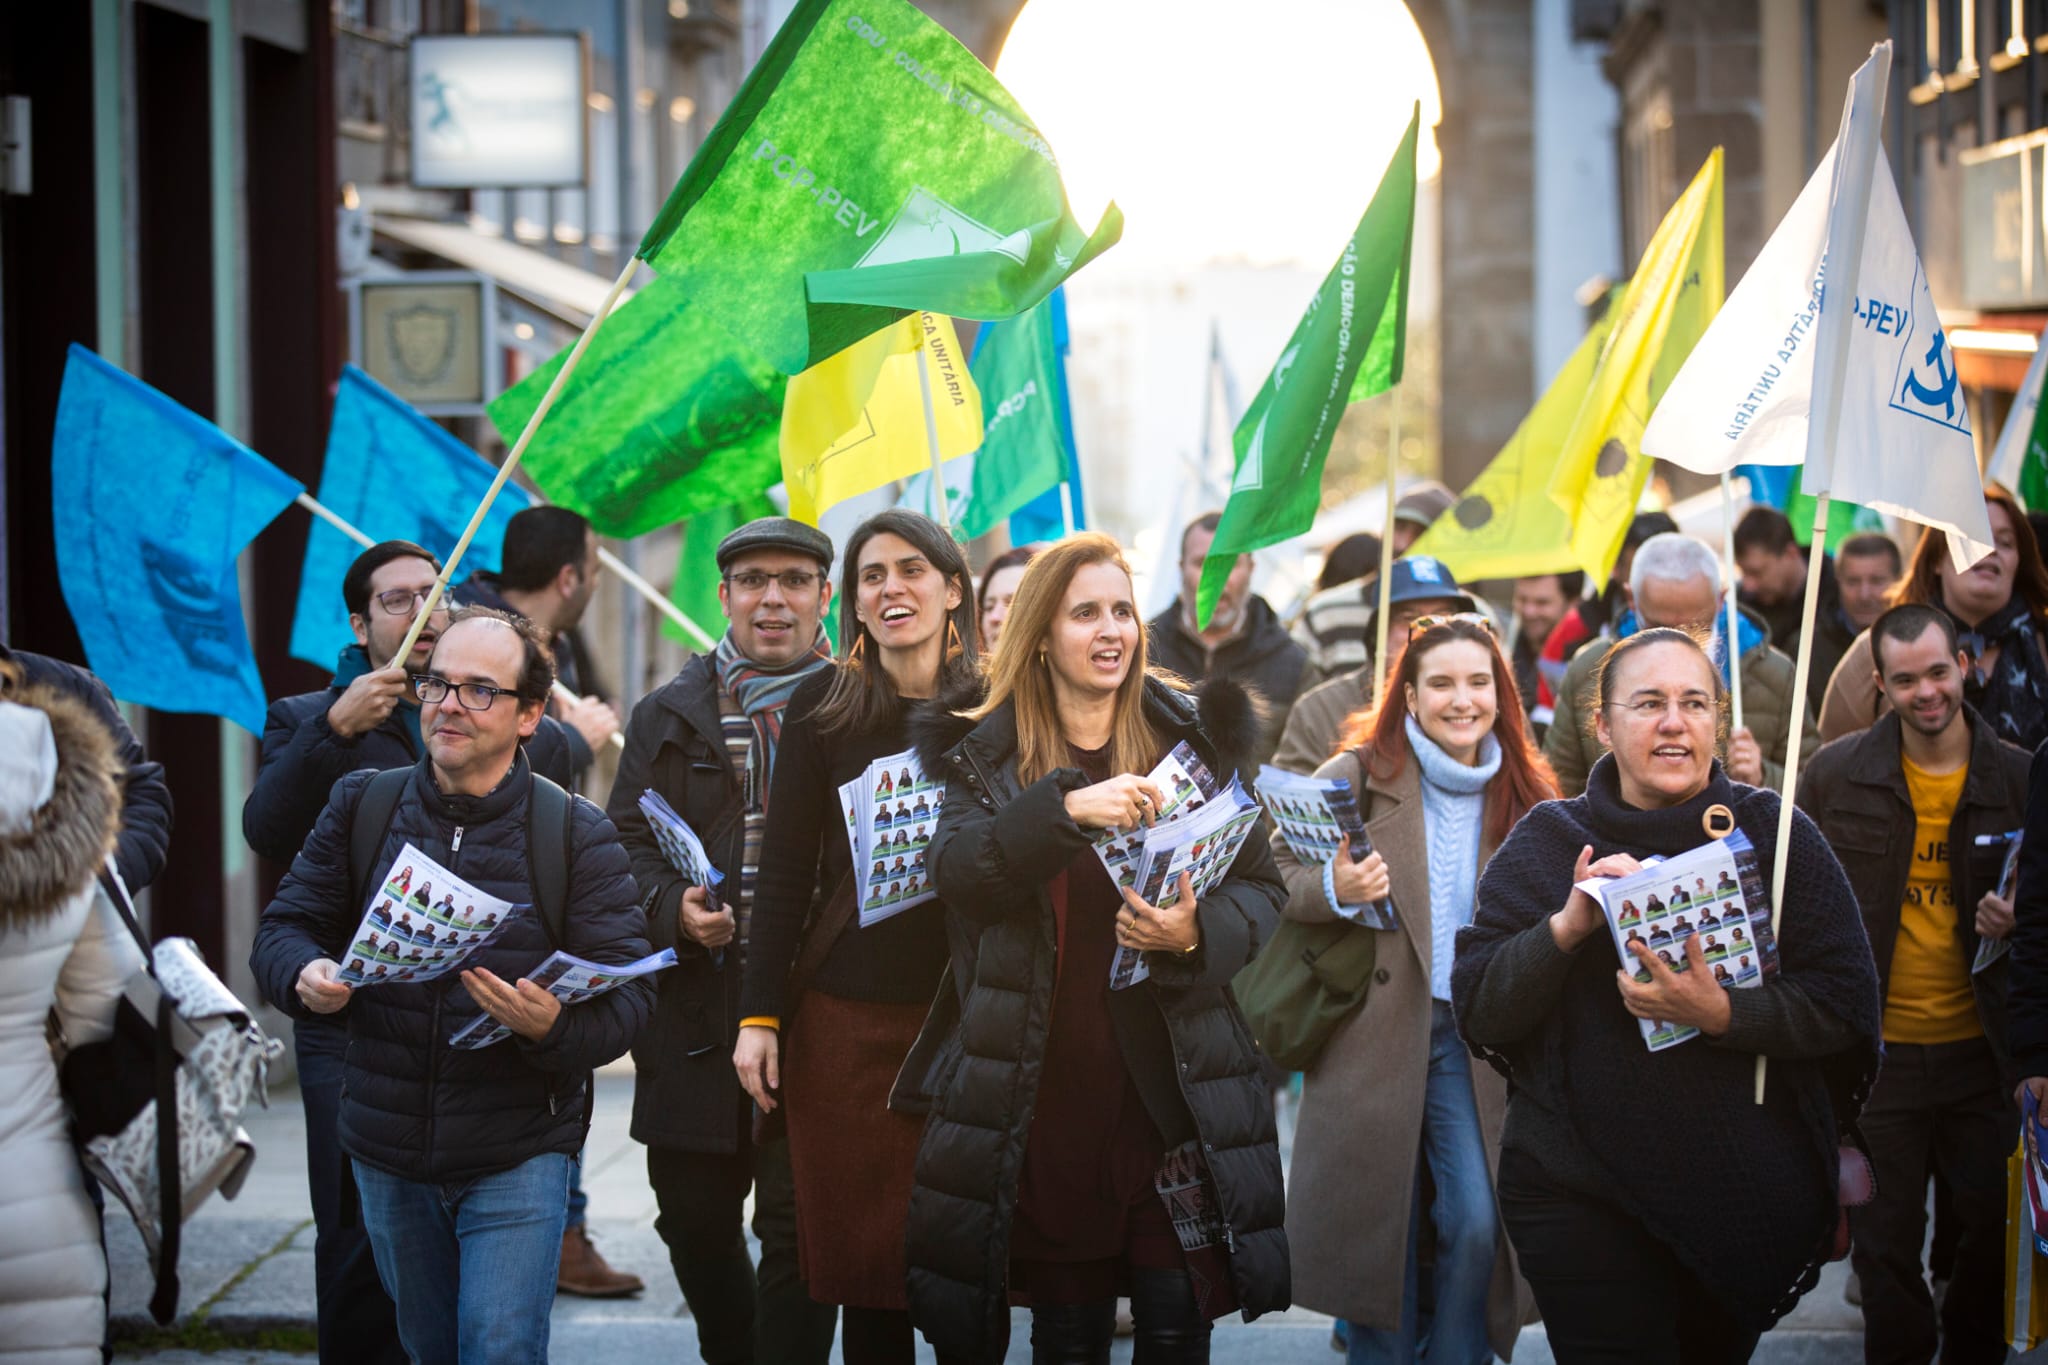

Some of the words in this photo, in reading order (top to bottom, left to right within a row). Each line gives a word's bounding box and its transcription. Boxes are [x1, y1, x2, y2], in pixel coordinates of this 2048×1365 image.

[847, 15, 887, 48] CDU
[752, 139, 880, 238] PCP-PEV
[930, 337, 966, 407] UNITÁRIA
